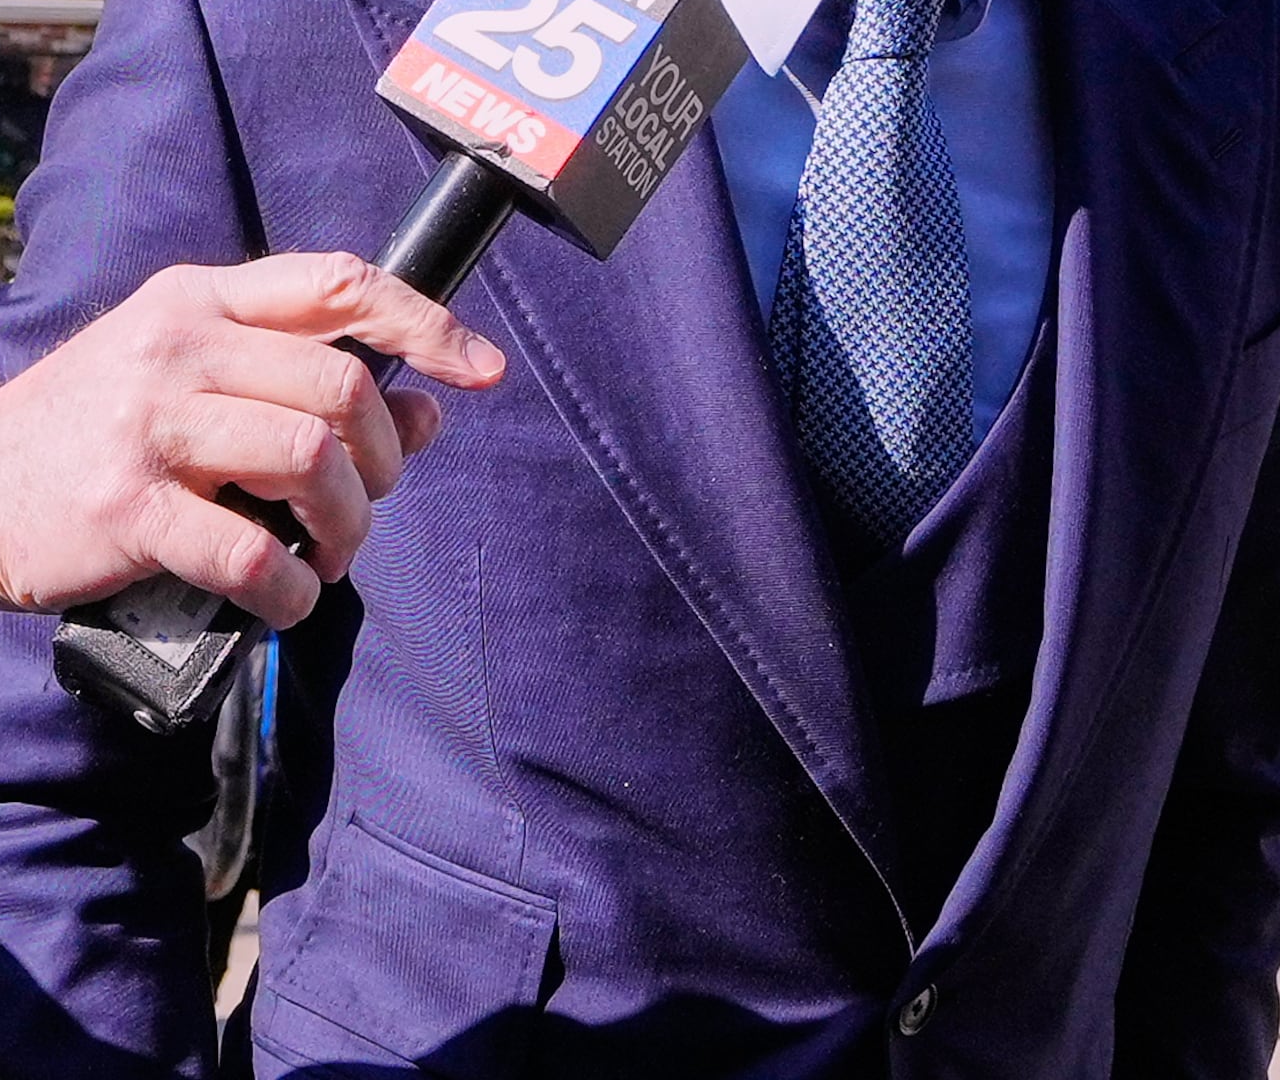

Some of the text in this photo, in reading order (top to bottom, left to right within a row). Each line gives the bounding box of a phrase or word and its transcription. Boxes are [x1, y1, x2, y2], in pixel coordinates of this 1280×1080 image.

[410, 63, 547, 155] NEWS
[613, 82, 679, 172] LOCAL
[640, 43, 704, 141] YOUR
[595, 115, 659, 200] STATION
